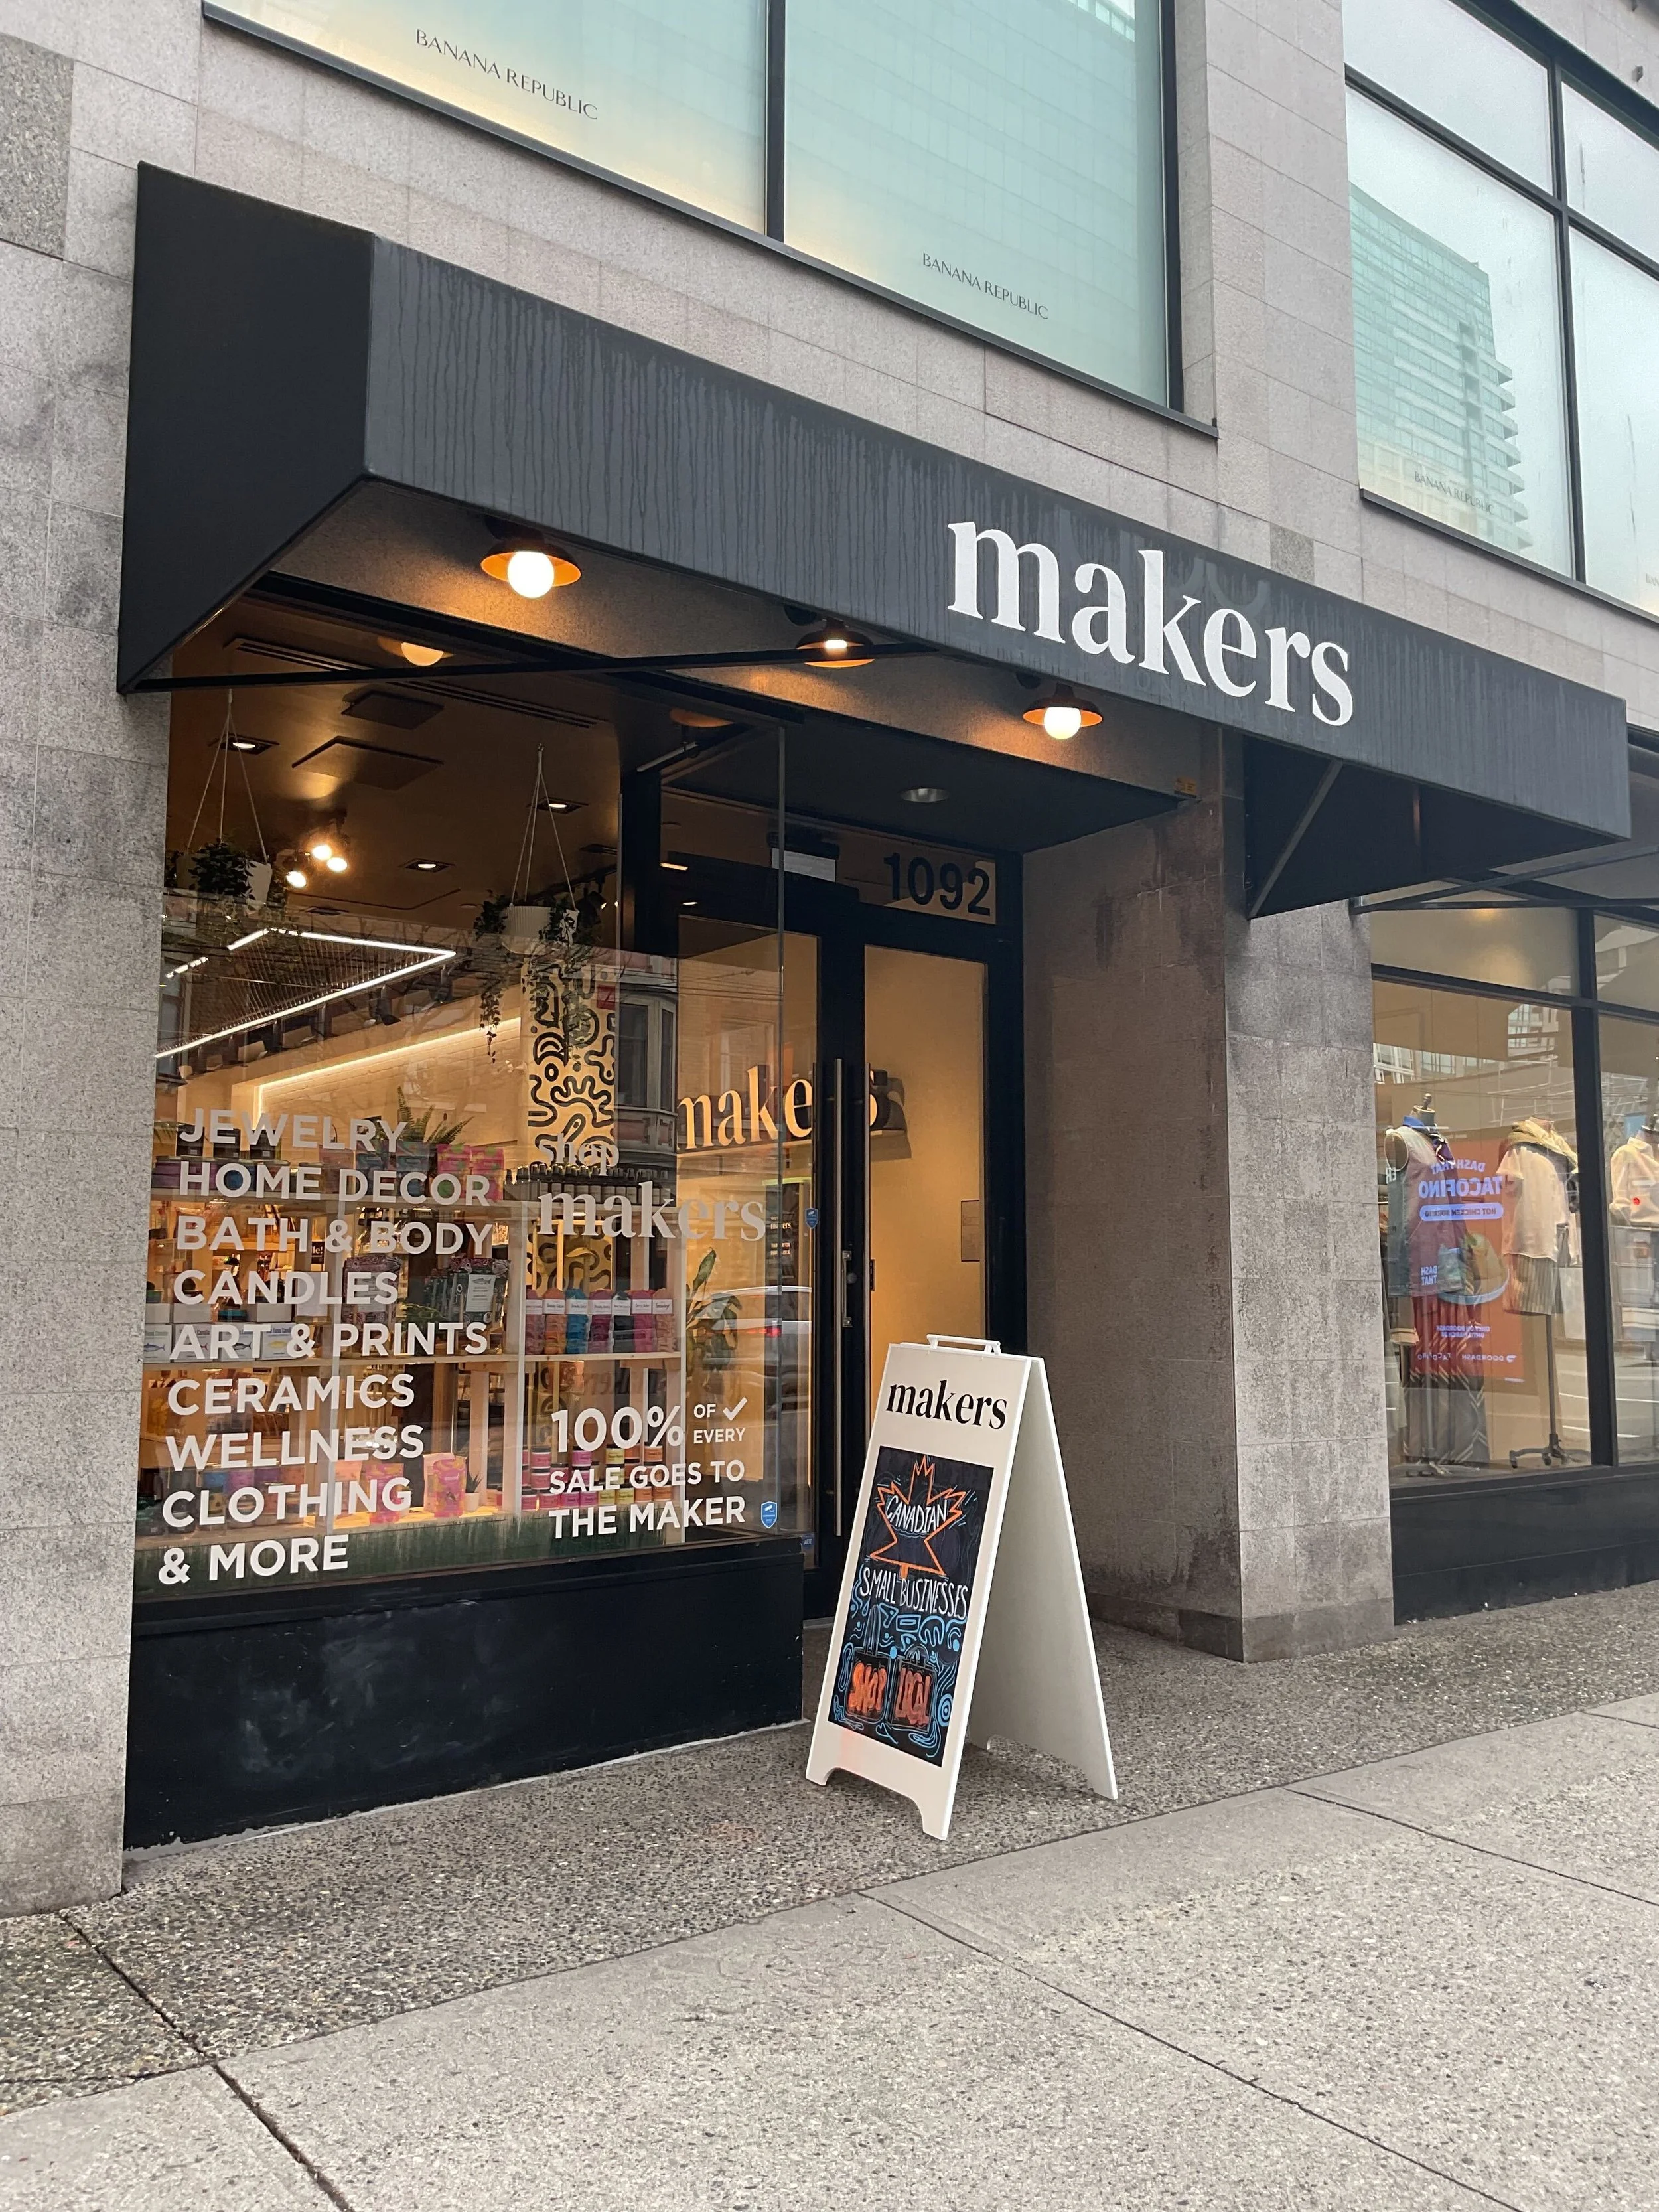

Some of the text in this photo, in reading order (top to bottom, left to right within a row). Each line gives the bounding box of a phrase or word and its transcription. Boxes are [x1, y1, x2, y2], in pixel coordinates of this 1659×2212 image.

[415, 29, 598, 119] BANANA REPUBLIC
[923, 252, 1048, 319] BANANA REPUBLIC
[1414, 471, 1494, 516] BANANA REPUBLIC
[947, 521, 1353, 727] makers
[883, 852, 991, 916] 1092
[179, 1108, 407, 1153] JEWELRY
[538, 1132, 620, 1176] shop
[179, 1161, 490, 1207] HOME DECOR
[538, 1180, 766, 1242] makers
[177, 1215, 495, 1256] BATH & BODY
[173, 1269, 398, 1305] CANDLES
[169, 1322, 488, 1361] ART & PRINTS
[167, 1374, 415, 1416] CERAMICS
[885, 1379, 1007, 1430] makers
[166, 1424, 424, 1471] WELLNESS
[551, 1403, 716, 1453] 100% OF
[693, 1426, 746, 1445] EVERY
[549, 1459, 745, 1495] SALE GOES TO
[163, 1477, 411, 1528] CLOTHING
[549, 1495, 745, 1540] THE MAKER
[885, 1495, 948, 1534] CANADIAN
[159, 1534, 349, 1585] & MORE
[859, 1567, 968, 1620] SMALL BUSINESSES
[895, 1666, 932, 1726] LOCAL
